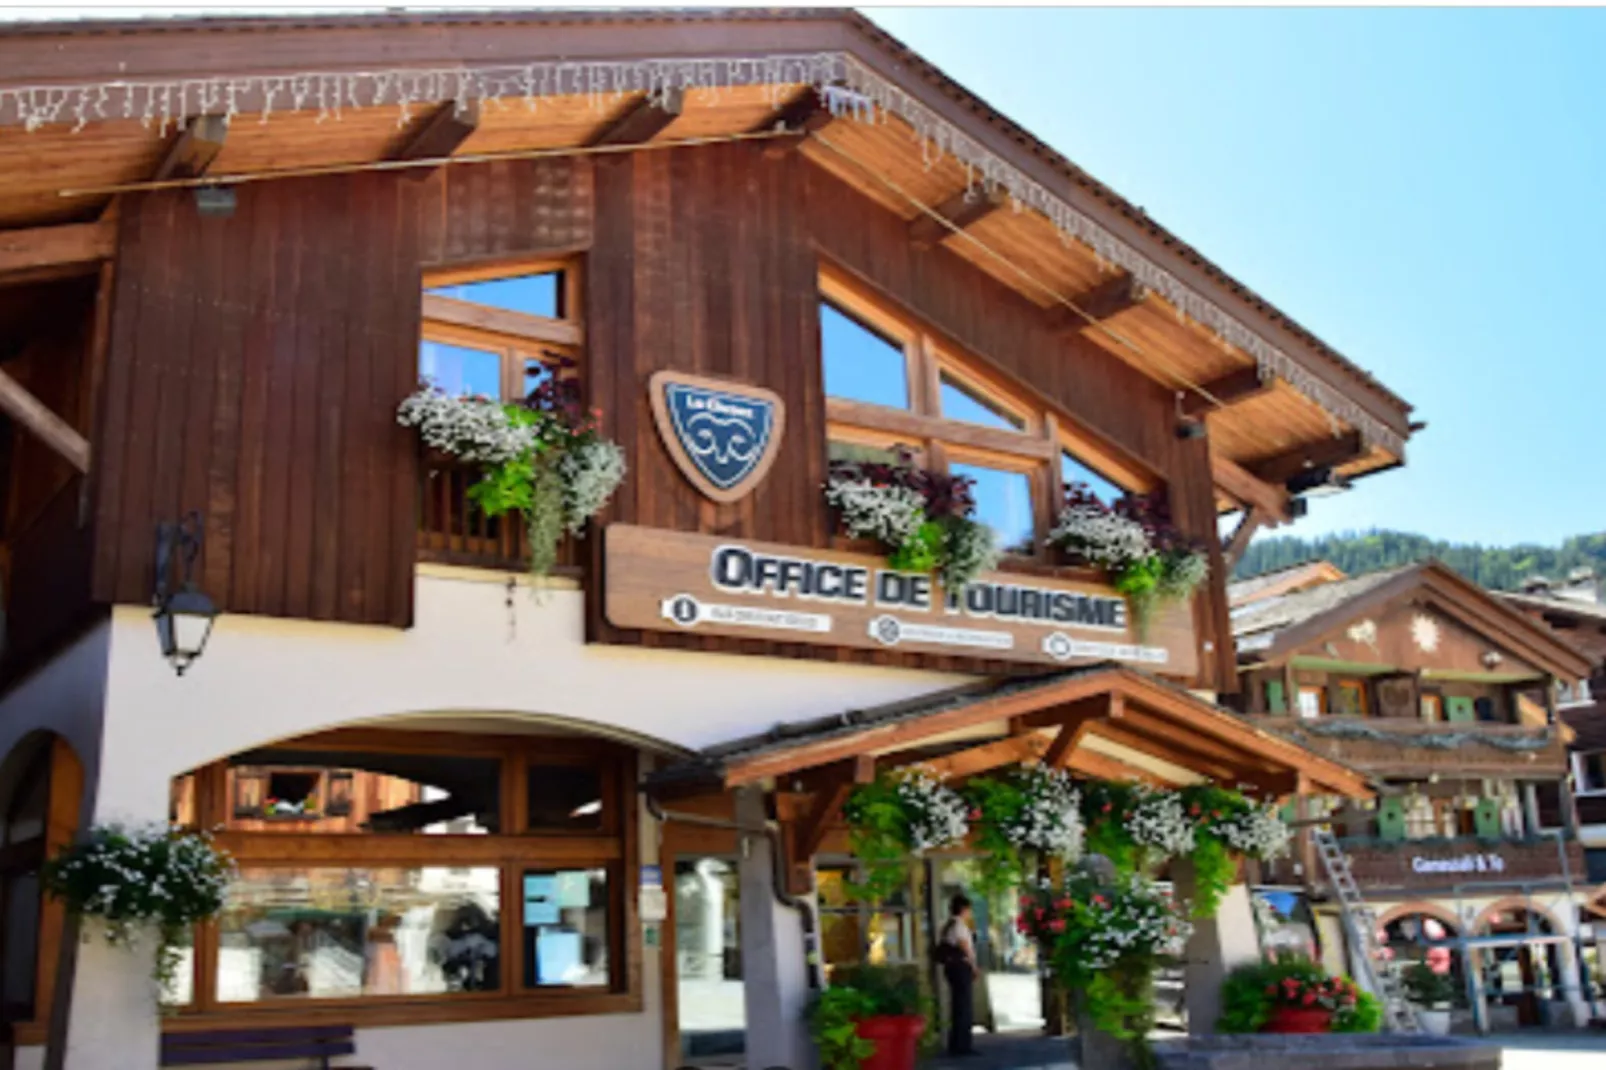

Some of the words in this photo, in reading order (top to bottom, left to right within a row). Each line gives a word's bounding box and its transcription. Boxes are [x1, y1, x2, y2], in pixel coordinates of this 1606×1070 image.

[686, 394, 704, 409] La
[712, 545, 867, 603] OFFICE
[876, 570, 930, 609] DE
